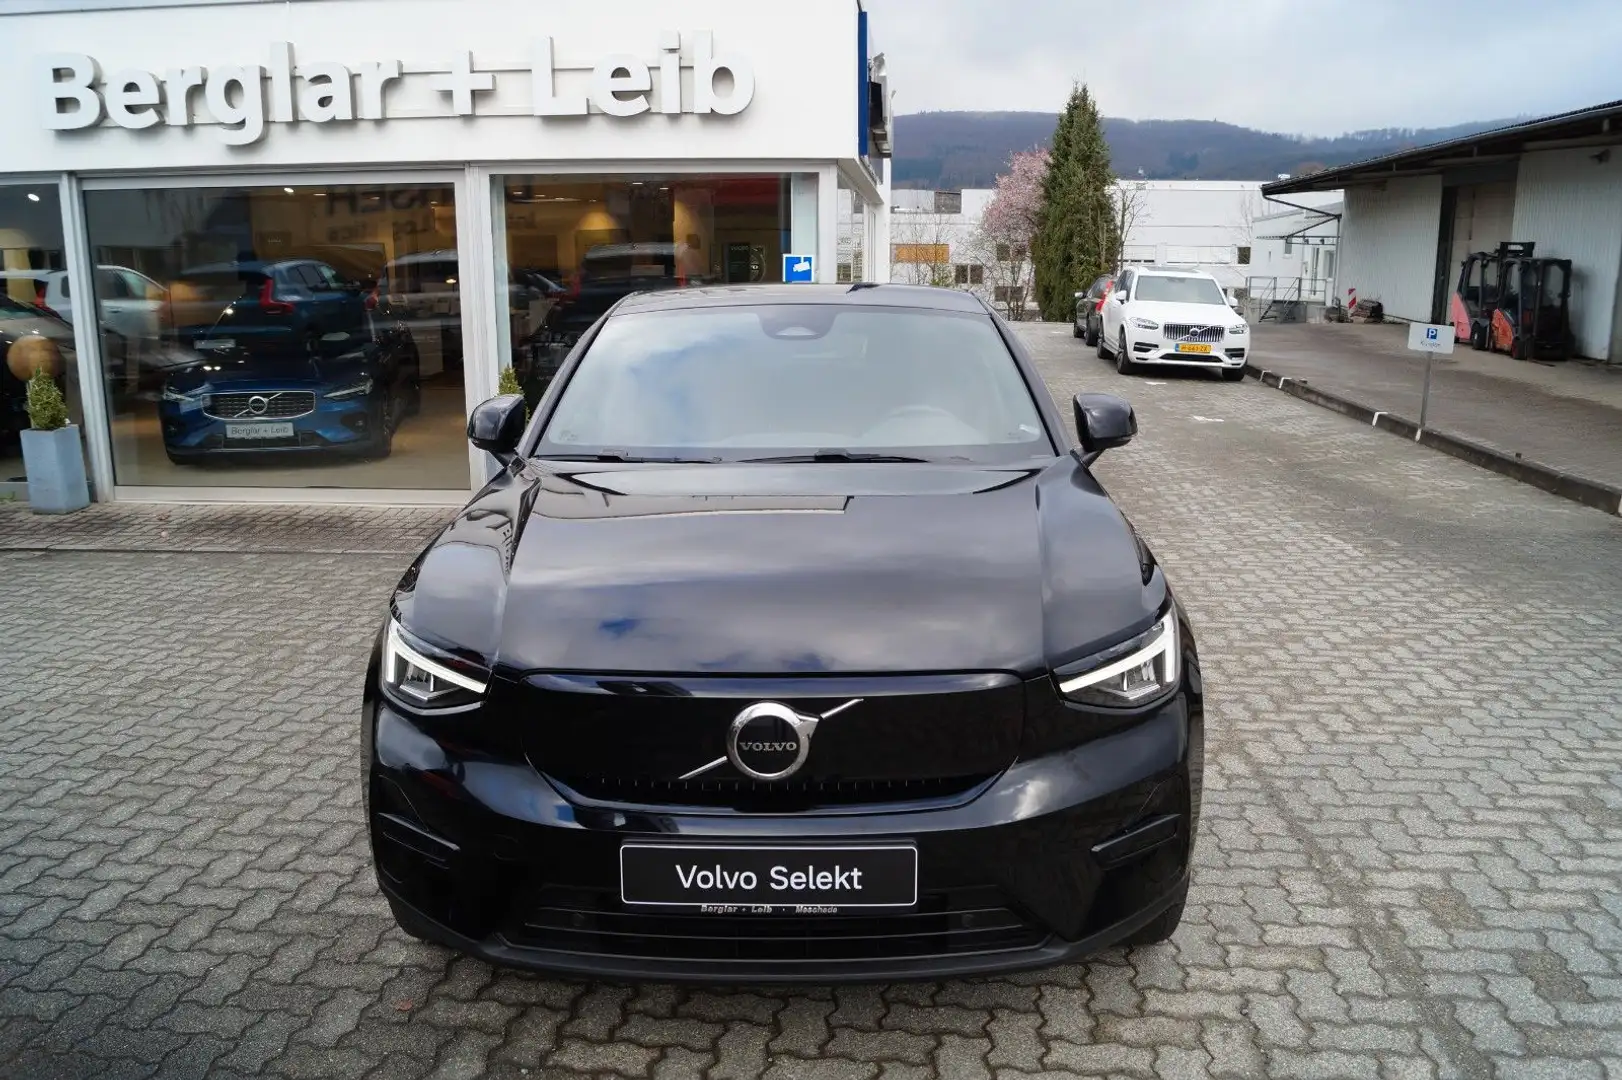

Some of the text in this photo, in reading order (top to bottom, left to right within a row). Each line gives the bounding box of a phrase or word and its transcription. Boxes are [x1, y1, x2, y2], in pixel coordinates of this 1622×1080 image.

[37, 29, 756, 146] Berglar + Leib
[231, 426, 260, 436] Berglar
[270, 426, 289, 434] Leib
[739, 742, 797, 751] VOLVO
[675, 864, 862, 890] Volvo Selekt
[700, 904, 738, 913] Berglar
[751, 905, 773, 913] Leib
[795, 905, 838, 914] Meschede
